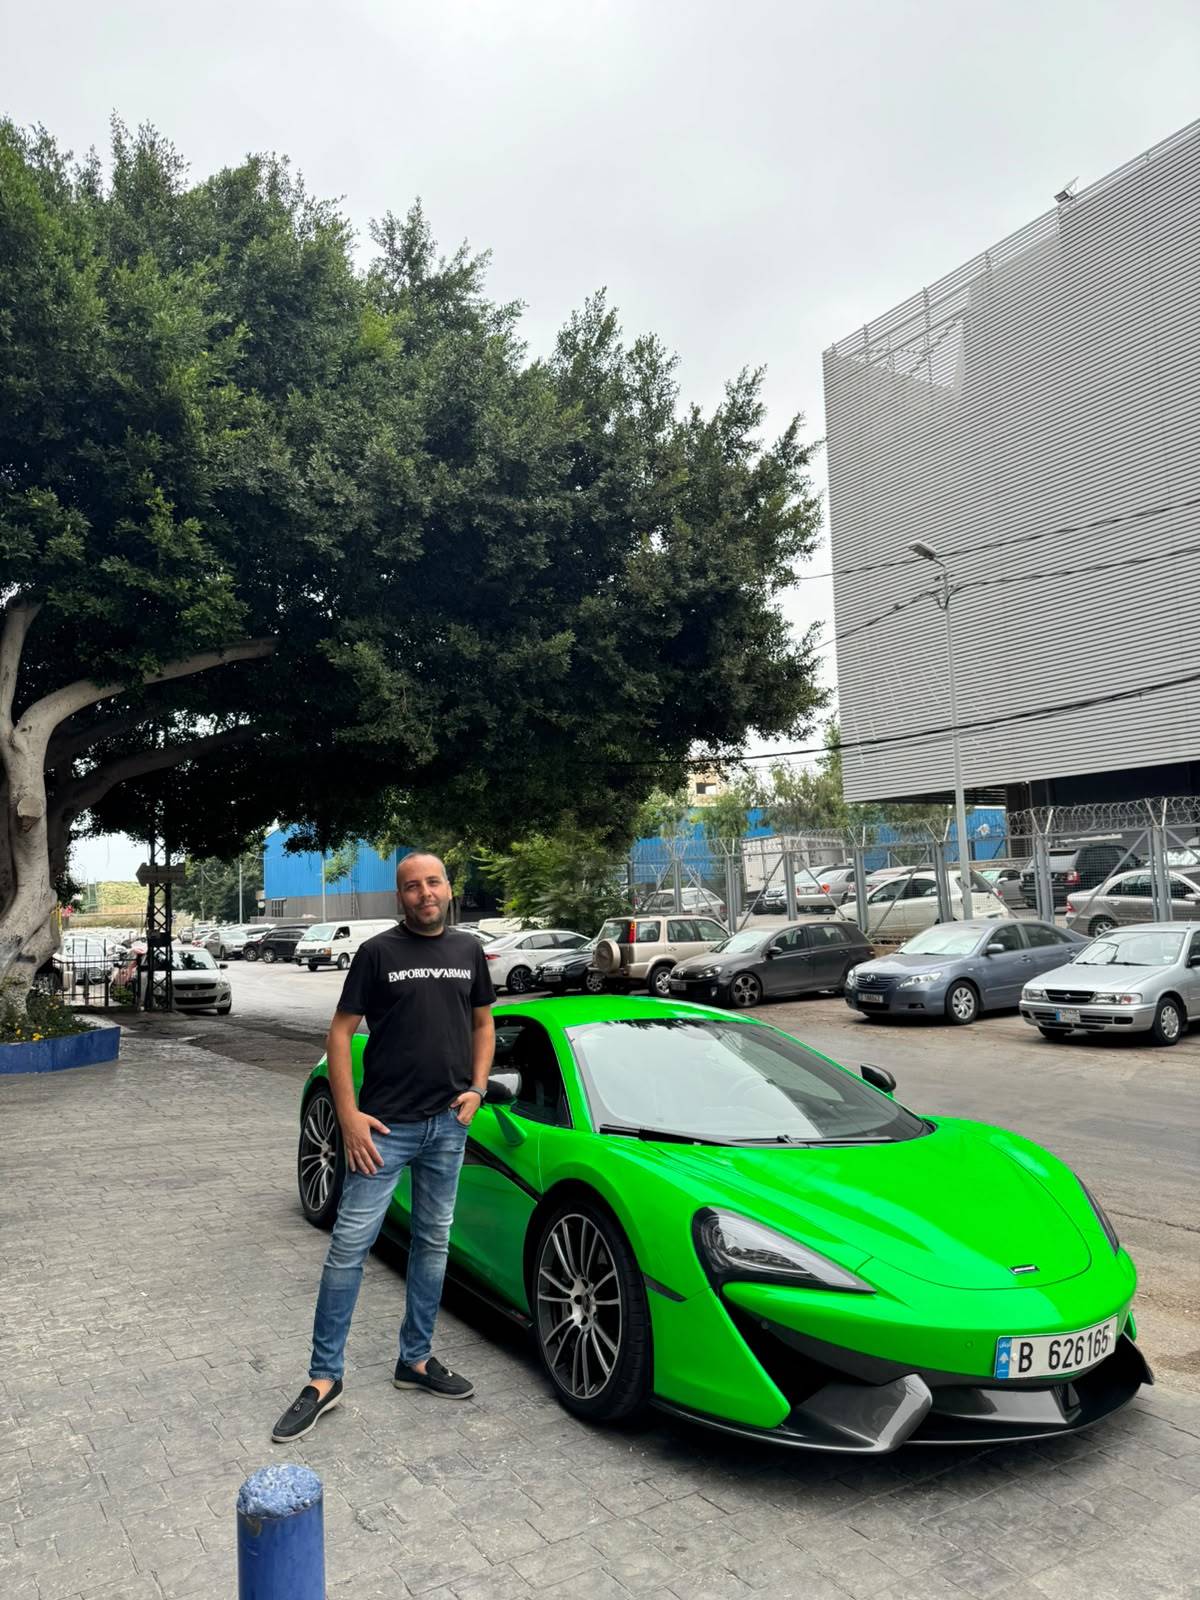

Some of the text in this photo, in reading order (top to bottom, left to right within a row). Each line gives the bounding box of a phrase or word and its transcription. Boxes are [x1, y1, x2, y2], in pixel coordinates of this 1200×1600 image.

[388, 968, 430, 983] EMPORIO
[1018, 1324, 1110, 1373] B 626165
